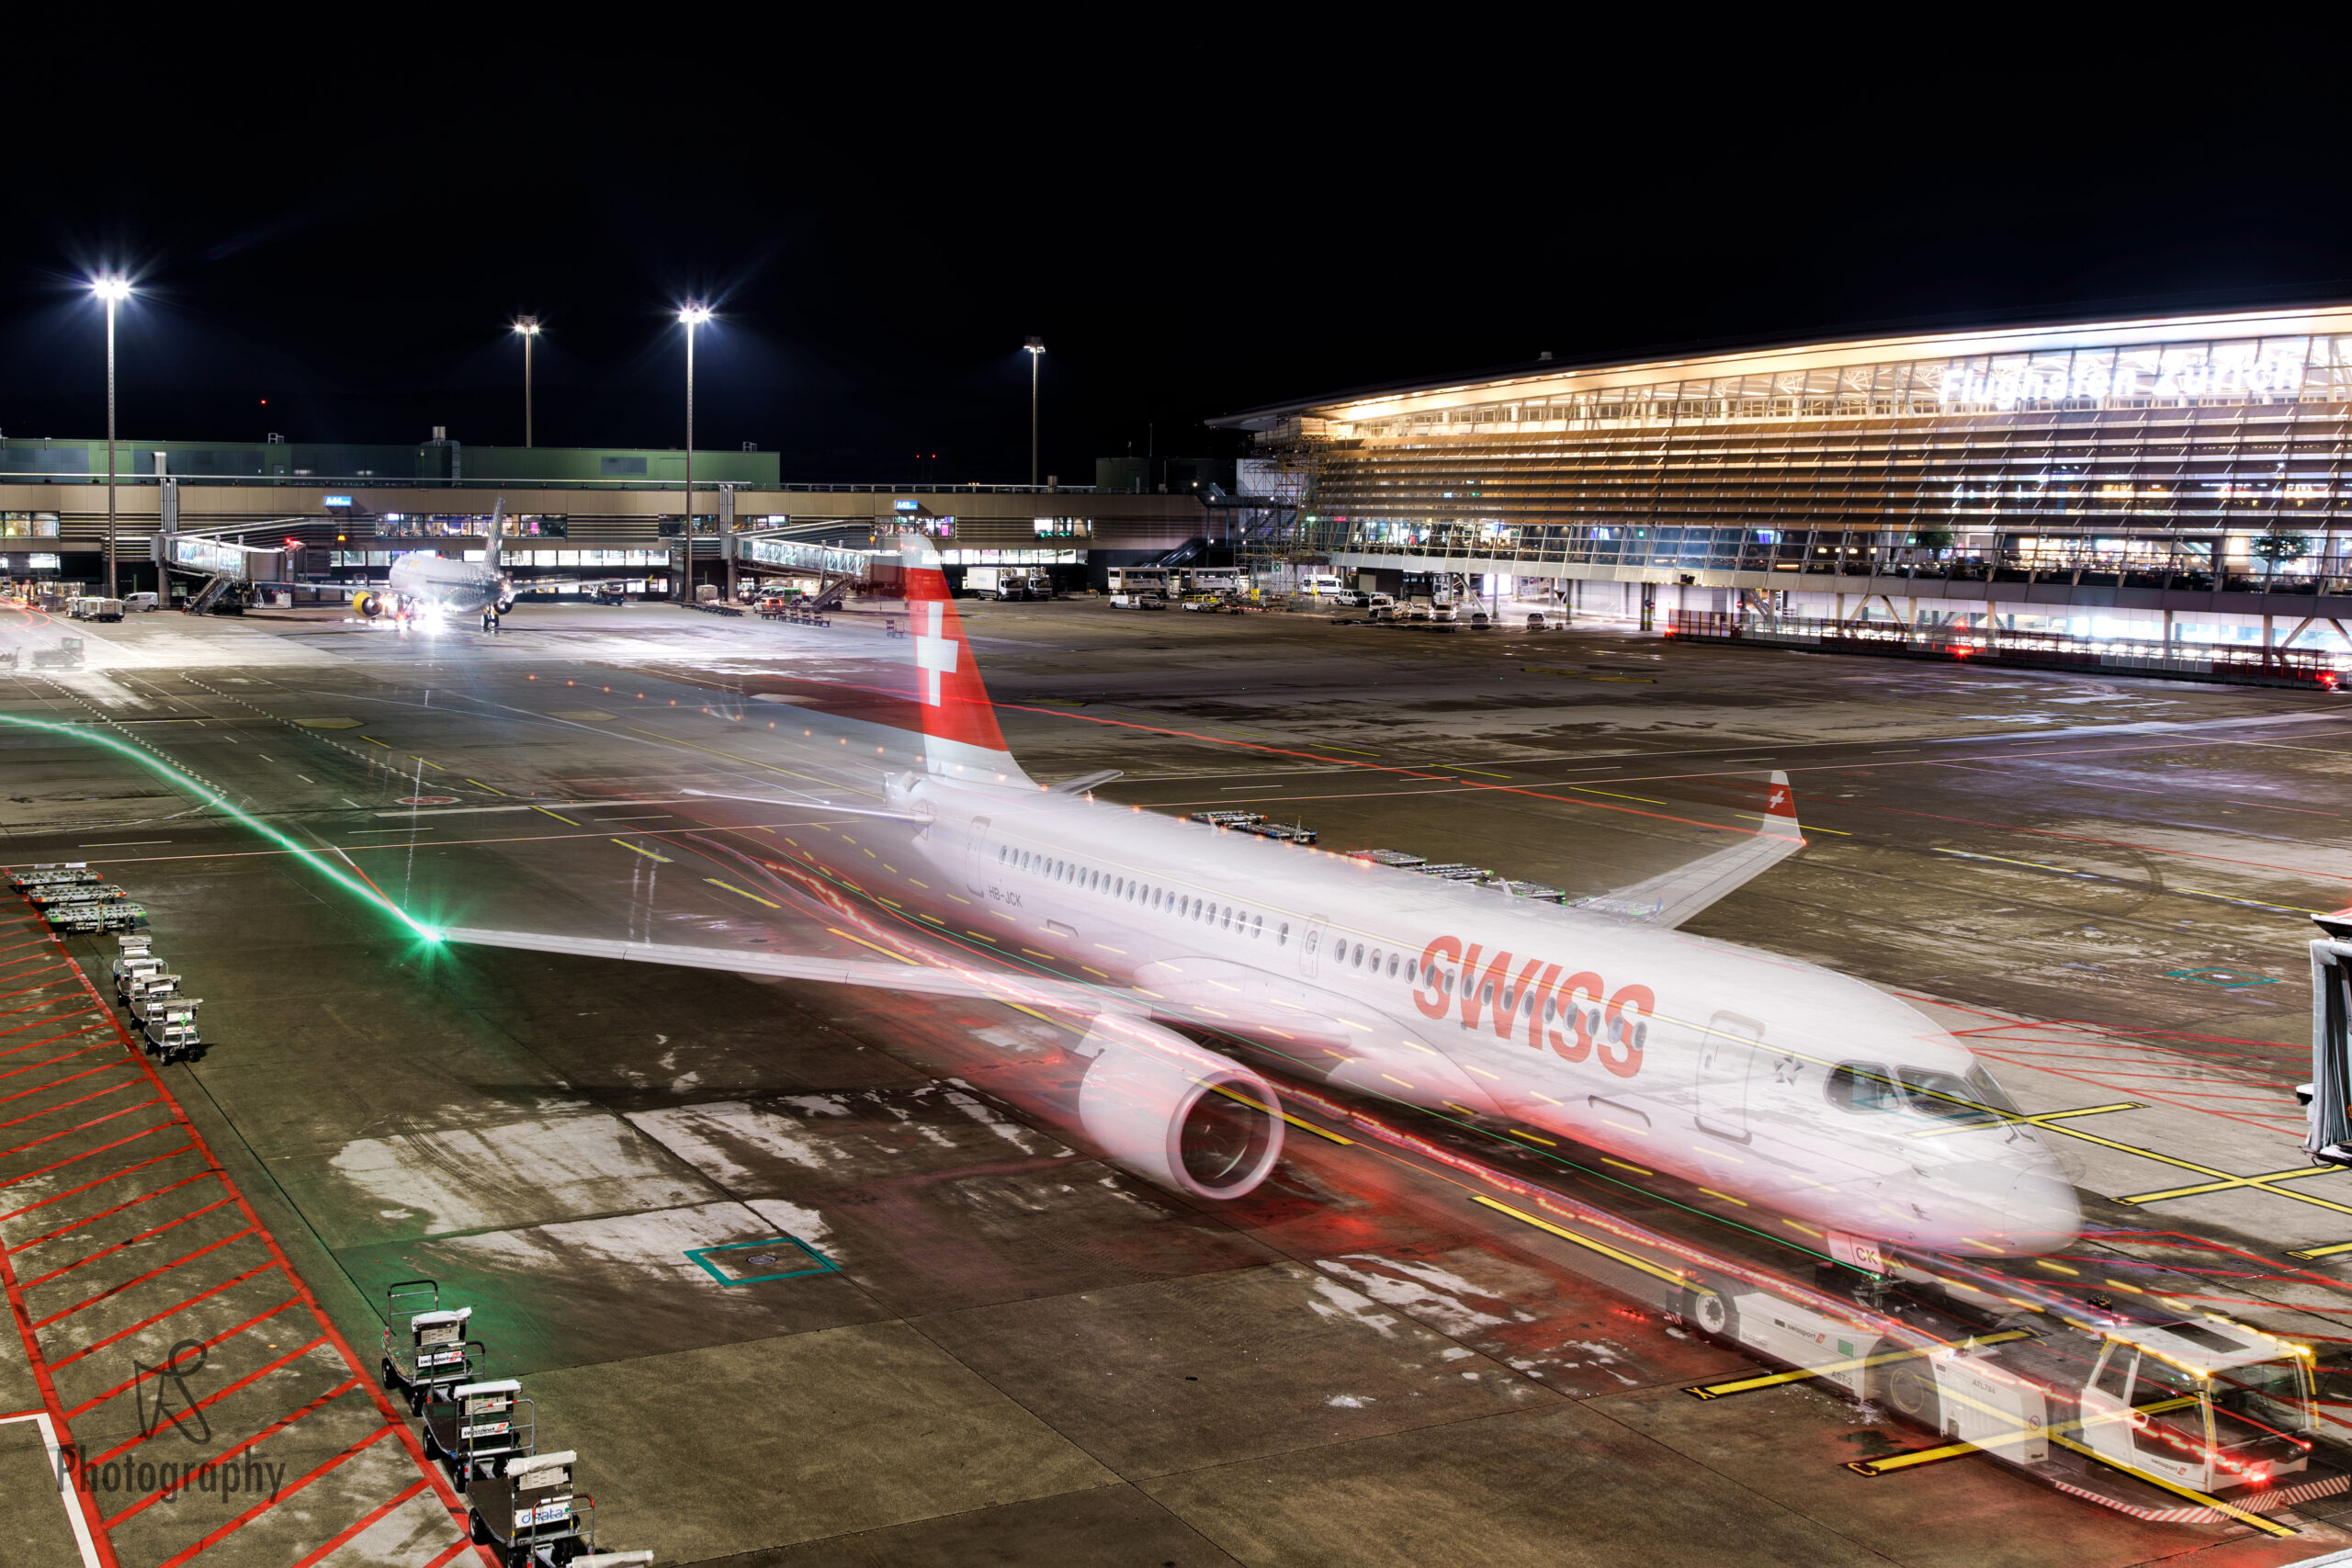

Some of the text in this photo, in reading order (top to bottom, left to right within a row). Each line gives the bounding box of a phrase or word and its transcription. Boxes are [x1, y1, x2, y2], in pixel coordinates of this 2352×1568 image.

[1939, 365, 2138, 409] Flughafen
[989, 884, 1023, 908] HB-JCK
[1412, 935, 1656, 1078] SWISS
[1856, 1247, 1880, 1266] CK
[1787, 1323, 1816, 1340] swissport
[1830, 1370, 1854, 1386] AST-2
[521, 1507, 563, 1524] dnata
